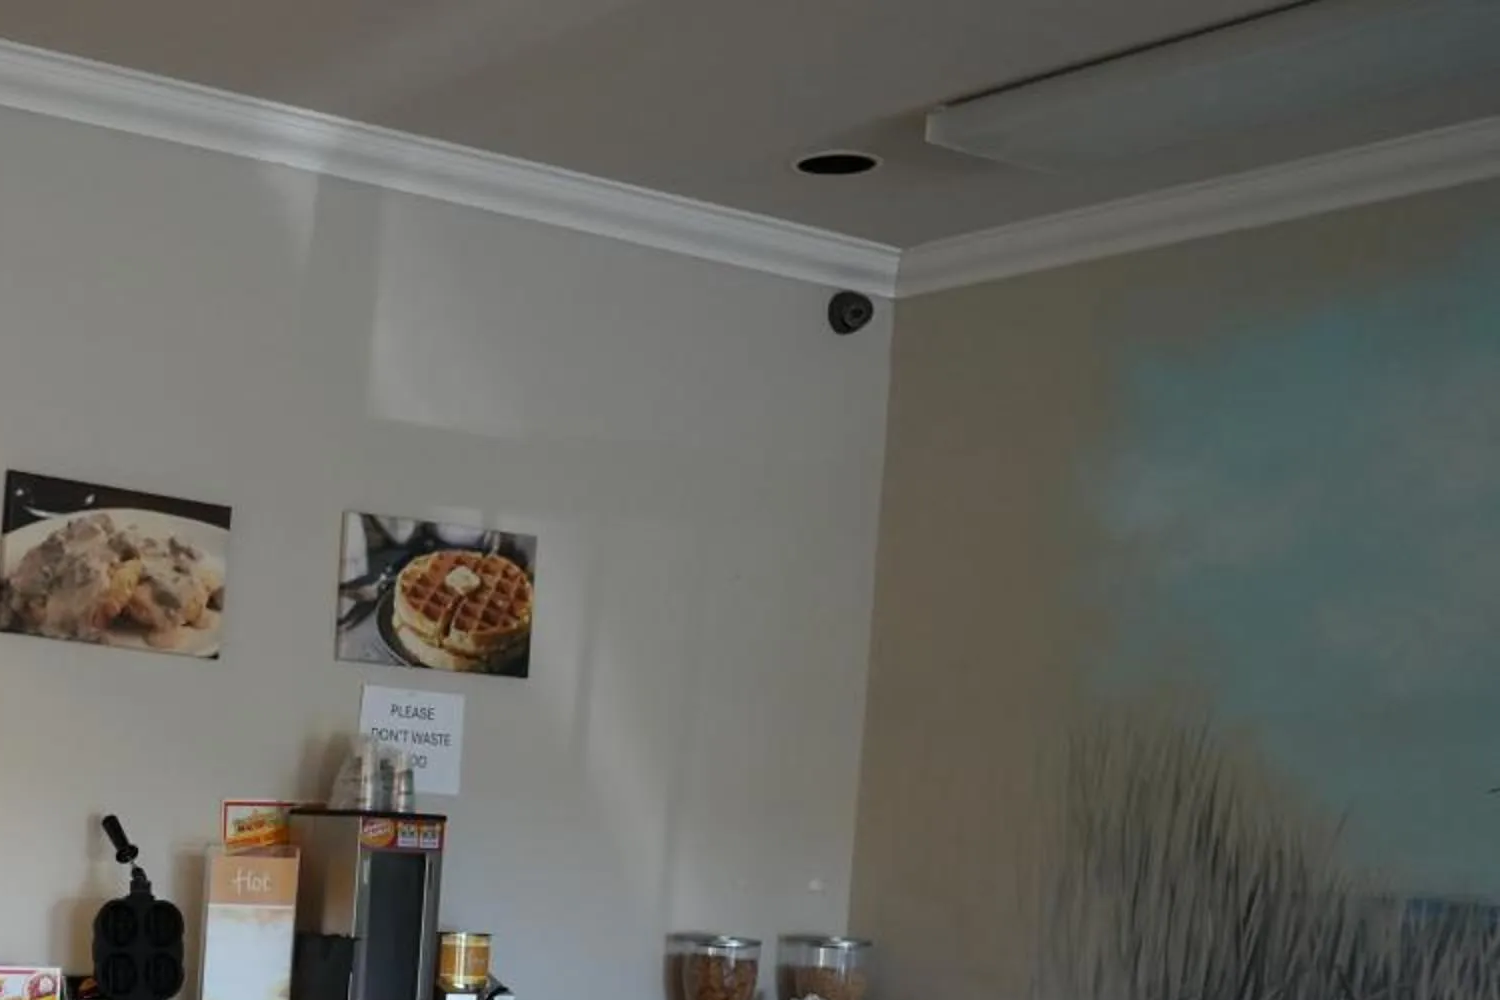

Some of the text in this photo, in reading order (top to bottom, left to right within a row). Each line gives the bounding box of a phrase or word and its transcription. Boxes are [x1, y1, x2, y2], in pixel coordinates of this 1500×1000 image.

[390, 703, 436, 720] PLEASE
[371, 727, 453, 747] DON'T WASTE
[230, 866, 272, 897] Hot
